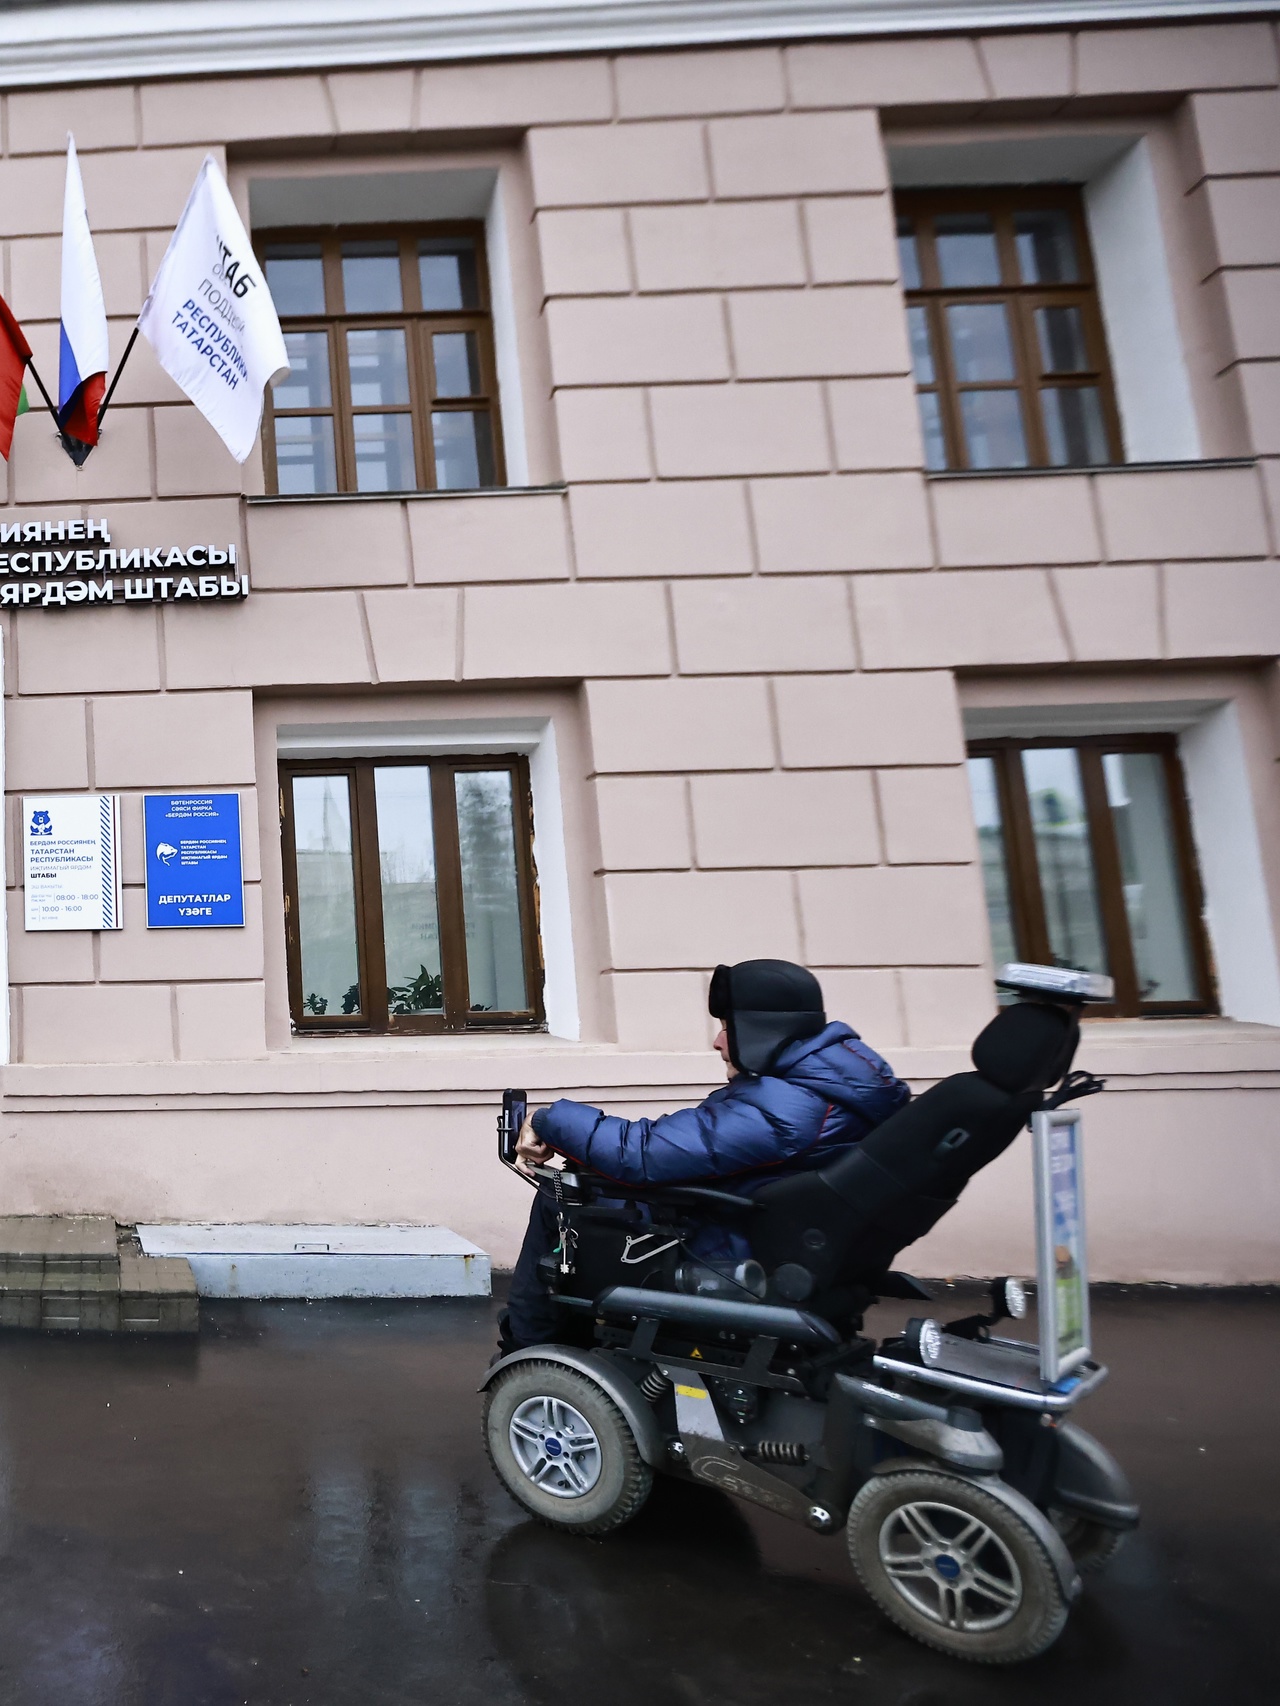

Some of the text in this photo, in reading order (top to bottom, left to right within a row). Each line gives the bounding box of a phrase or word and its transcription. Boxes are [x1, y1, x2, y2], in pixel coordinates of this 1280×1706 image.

[172, 311, 239, 390] ТАТАРСТАН
[0, 580, 114, 606] ЯРДӘМ
[124, 575, 249, 600] ШТАБЫ
[158, 893, 231, 905] ДЕПУТАТЛАР
[178, 907, 212, 916] ҮЗӘГЕ
